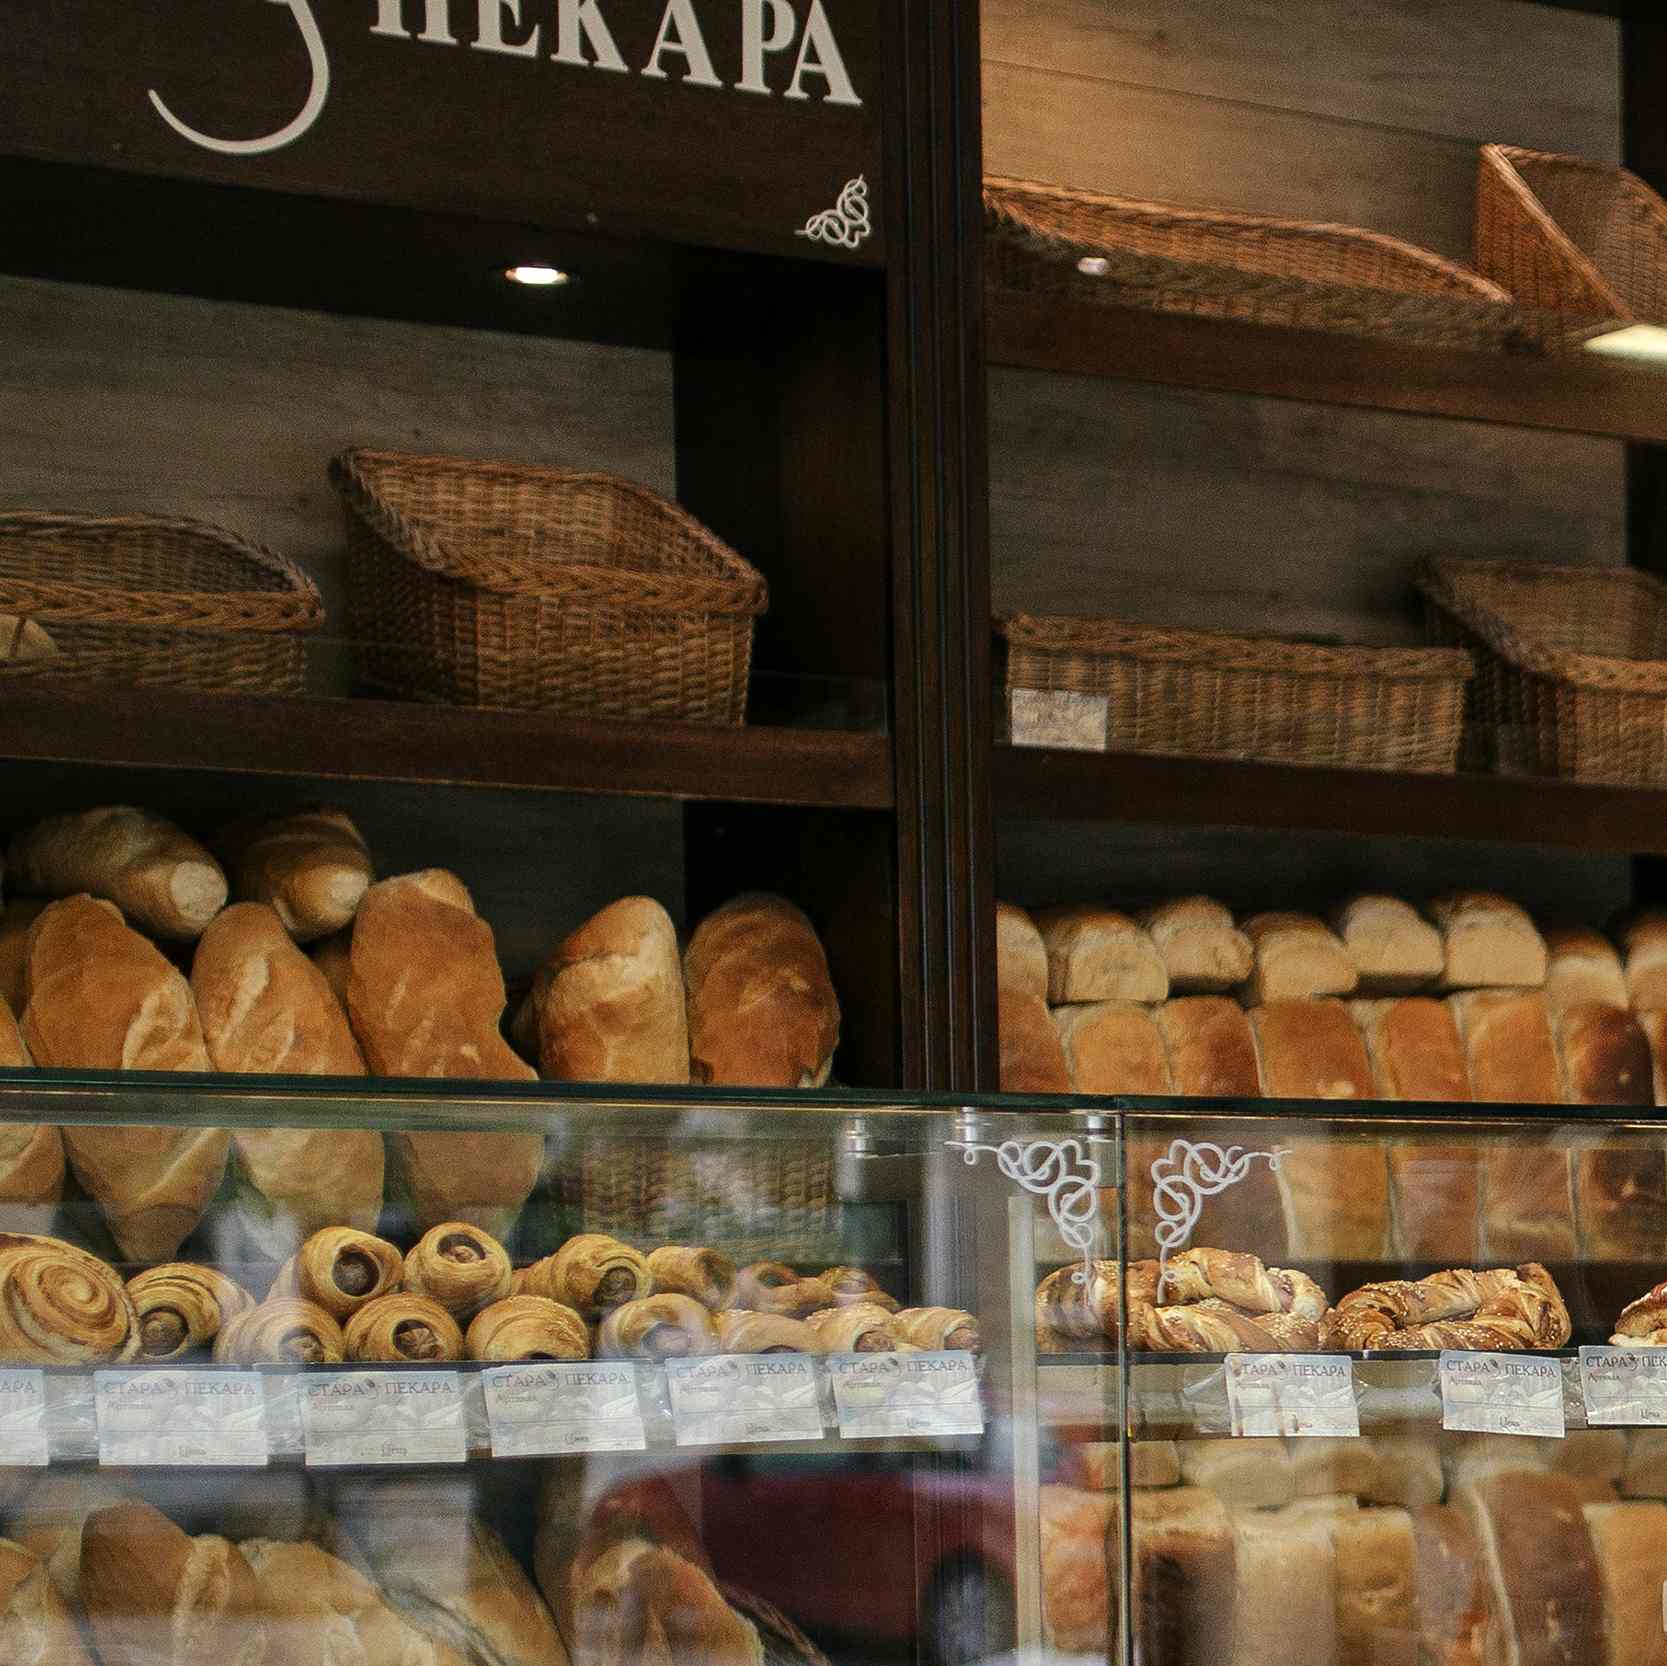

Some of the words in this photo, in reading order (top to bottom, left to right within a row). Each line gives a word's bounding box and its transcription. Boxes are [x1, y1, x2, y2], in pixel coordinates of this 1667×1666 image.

[839, 1362, 890, 1374] СТАРА
[906, 1360, 968, 1372] ПЕКАРА
[1446, 1360, 1490, 1373] СТАРА
[1505, 1364, 1556, 1377] ПЕКАРА
[1586, 1356, 1628, 1368] СТАРА
[676, 1366, 729, 1378] СТАРА
[746, 1363, 808, 1375] ПЕКАРА
[1234, 1363, 1278, 1376] ТАРА
[1293, 1364, 1346, 1377] ПЕКАРА
[0, 1380, 37, 1393] АРА
[493, 1375, 546, 1388] СТАРА
[565, 1373, 630, 1386] ПЕКАРА
[104, 1383, 163, 1395] СТАРА
[185, 1382, 256, 1395] ПЕКАРА
[308, 1383, 364, 1396] СТАРА
[385, 1381, 454, 1394] ПЕКАРА
